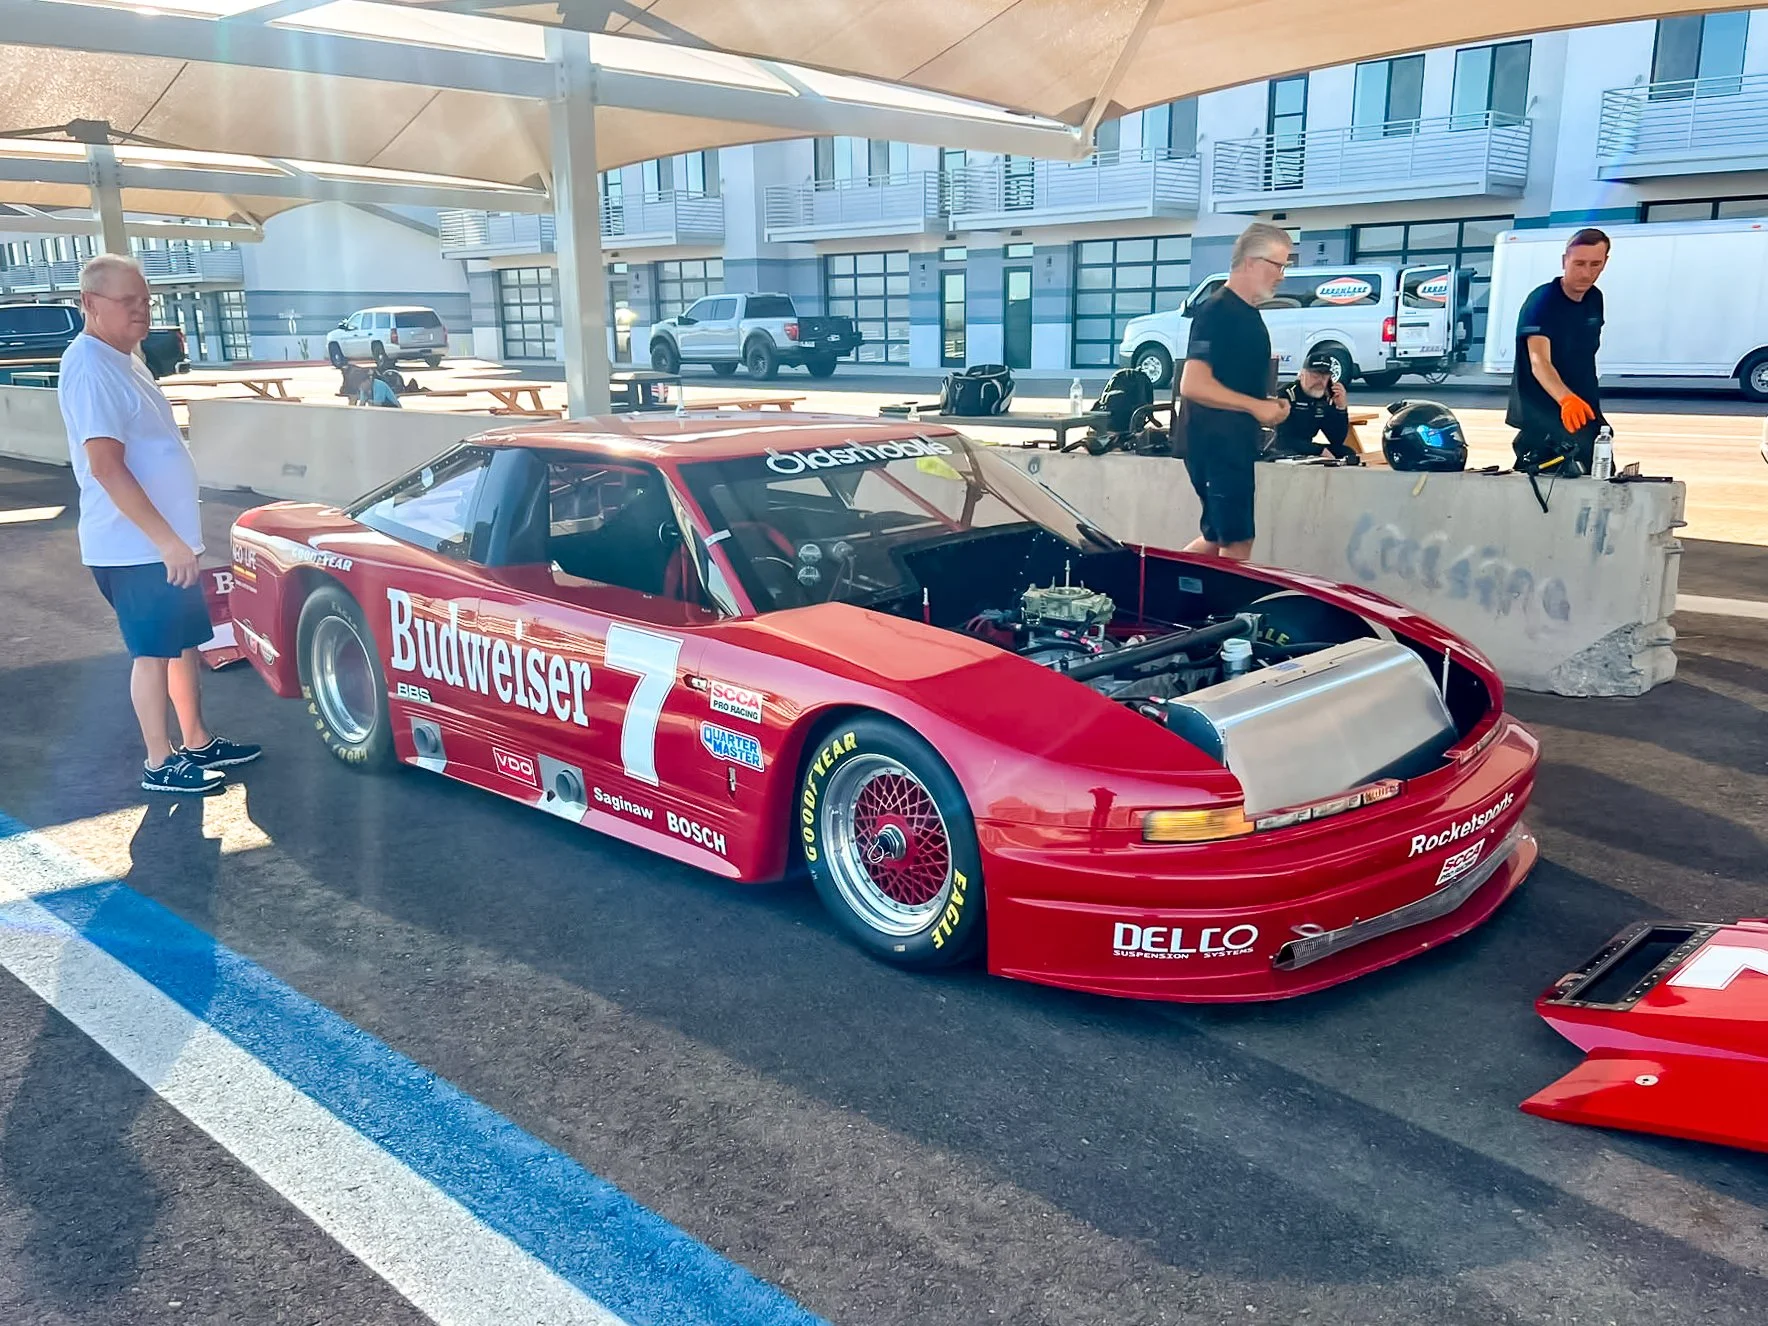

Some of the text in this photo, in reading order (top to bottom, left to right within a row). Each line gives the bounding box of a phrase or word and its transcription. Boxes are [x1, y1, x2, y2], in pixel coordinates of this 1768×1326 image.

[386, 587, 591, 728] Budweiser
[397, 682, 432, 703] BBS
[604, 622, 684, 787] 7
[713, 684, 760, 710] SCCA
[713, 700, 758, 720] PRO RACING
[704, 726, 758, 754] QUARTER
[713, 740, 760, 766] MASTER
[497, 752, 533, 777] VDO
[802, 731, 858, 862] GOODYEAR
[594, 787, 727, 856] Saginaw BOSCH
[1408, 792, 1514, 858] Rocketsports
[930, 868, 967, 950] EAGLE
[1113, 922, 1259, 953] DELCO
[1113, 947, 1254, 960] SUSPENSION SYSTEMS
